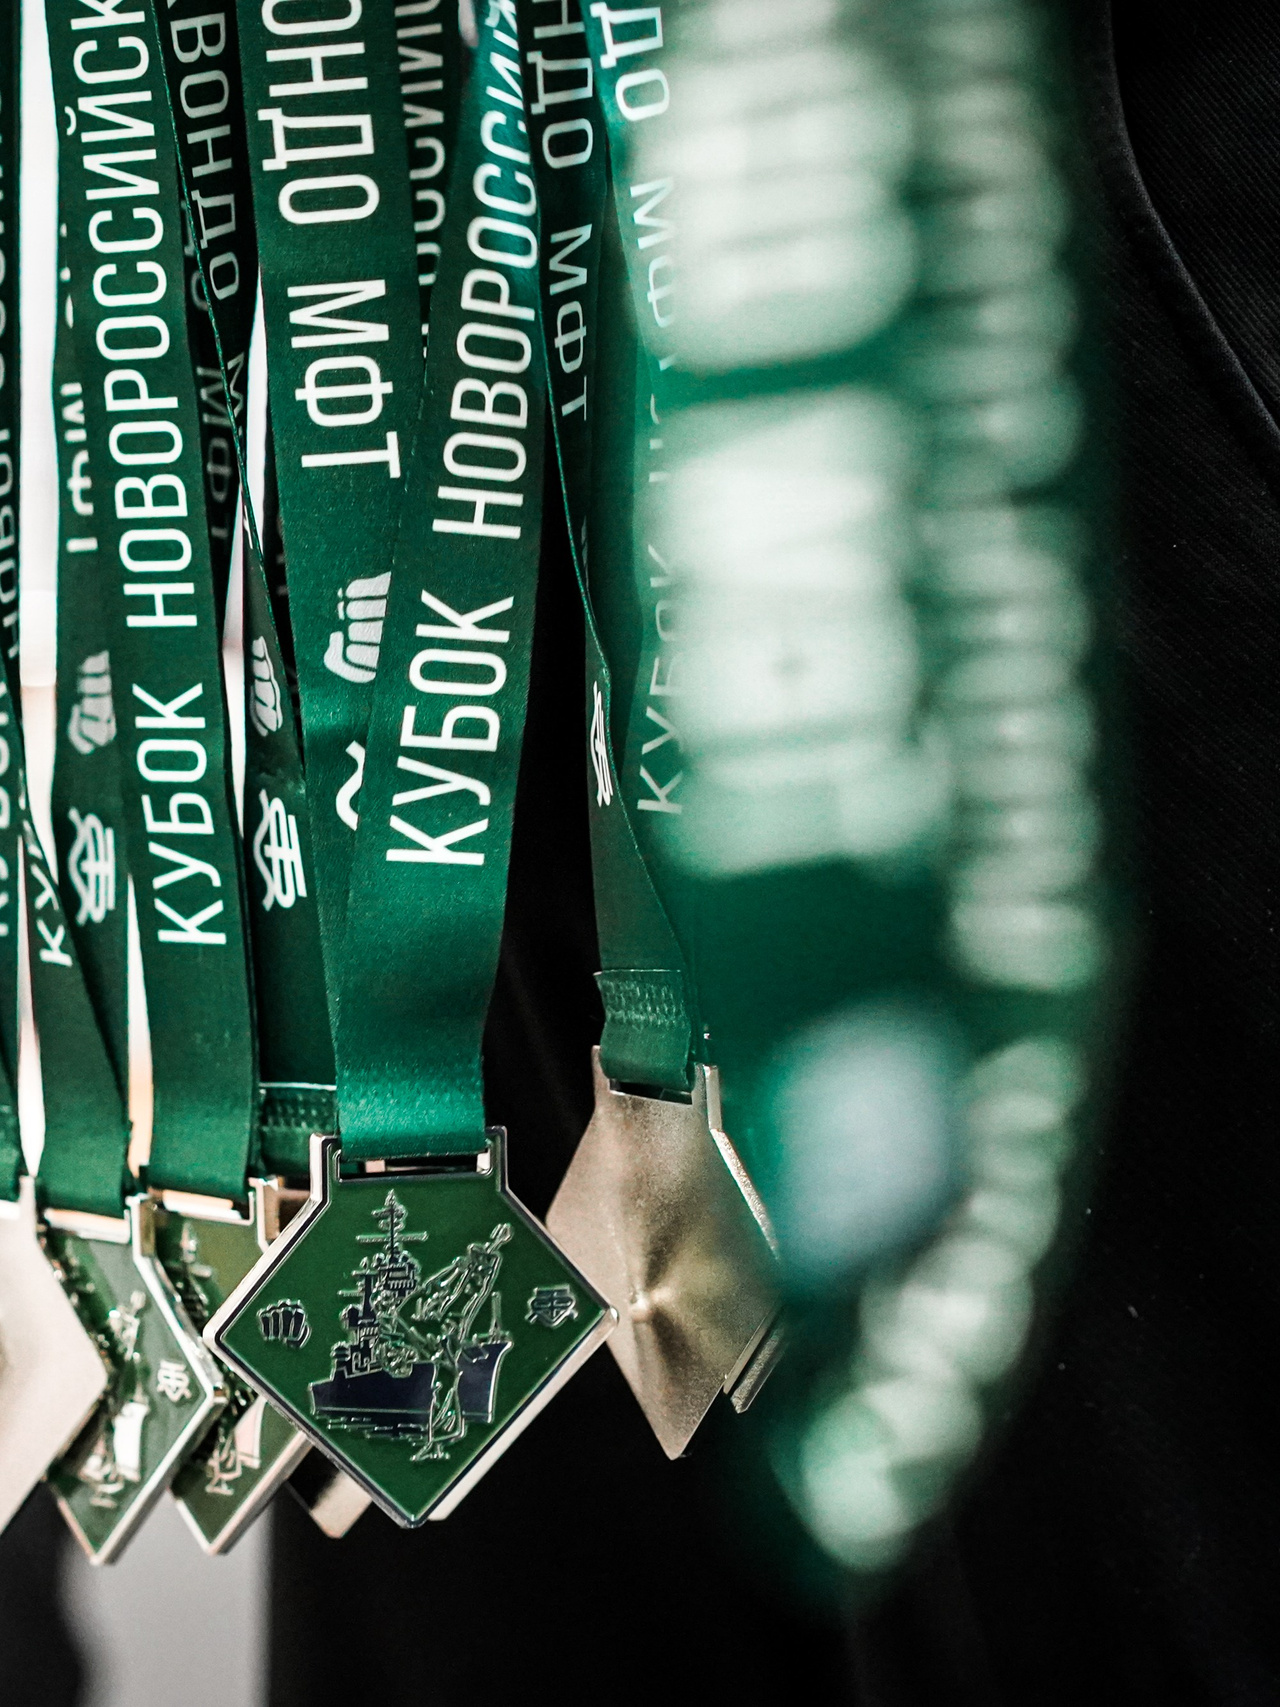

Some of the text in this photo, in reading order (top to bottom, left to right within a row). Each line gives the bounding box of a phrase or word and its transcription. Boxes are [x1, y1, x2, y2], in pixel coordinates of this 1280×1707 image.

[167, 0, 240, 300] ВОНДО
[286, 279, 401, 479] МФТ
[549, 223, 593, 421] МФТ
[131, 682, 227, 945] КУБОК
[386, 589, 515, 866] КУБОК
